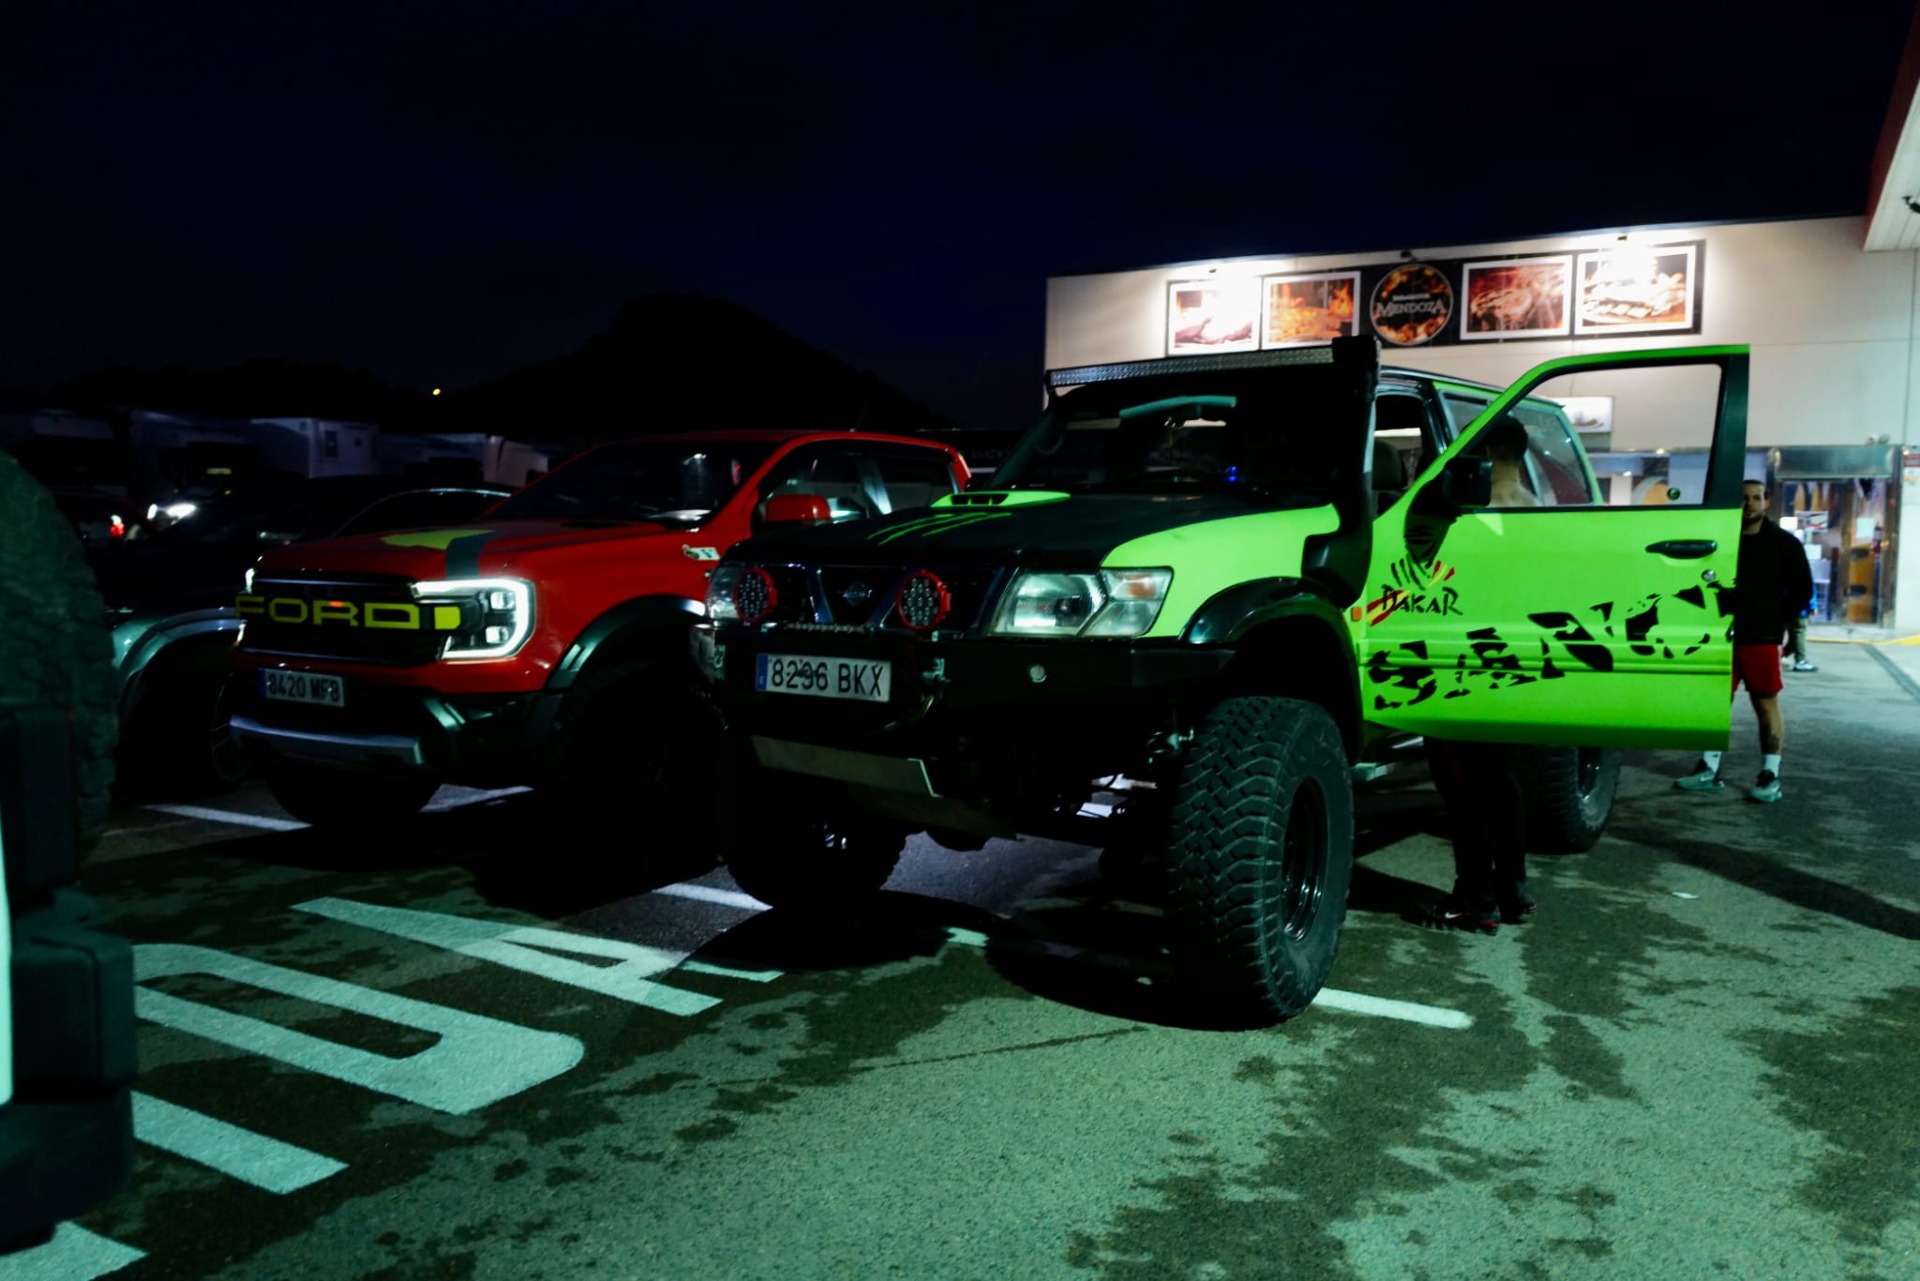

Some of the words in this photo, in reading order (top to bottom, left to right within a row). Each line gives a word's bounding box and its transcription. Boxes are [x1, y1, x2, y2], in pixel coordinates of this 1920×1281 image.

[1375, 298, 1447, 318] MENDOZA
[234, 595, 421, 631] FORD
[1381, 584, 1463, 616] DAKAR
[268, 673, 306, 698] 8420
[771, 658, 829, 691] 8296
[838, 663, 884, 697] BKX
